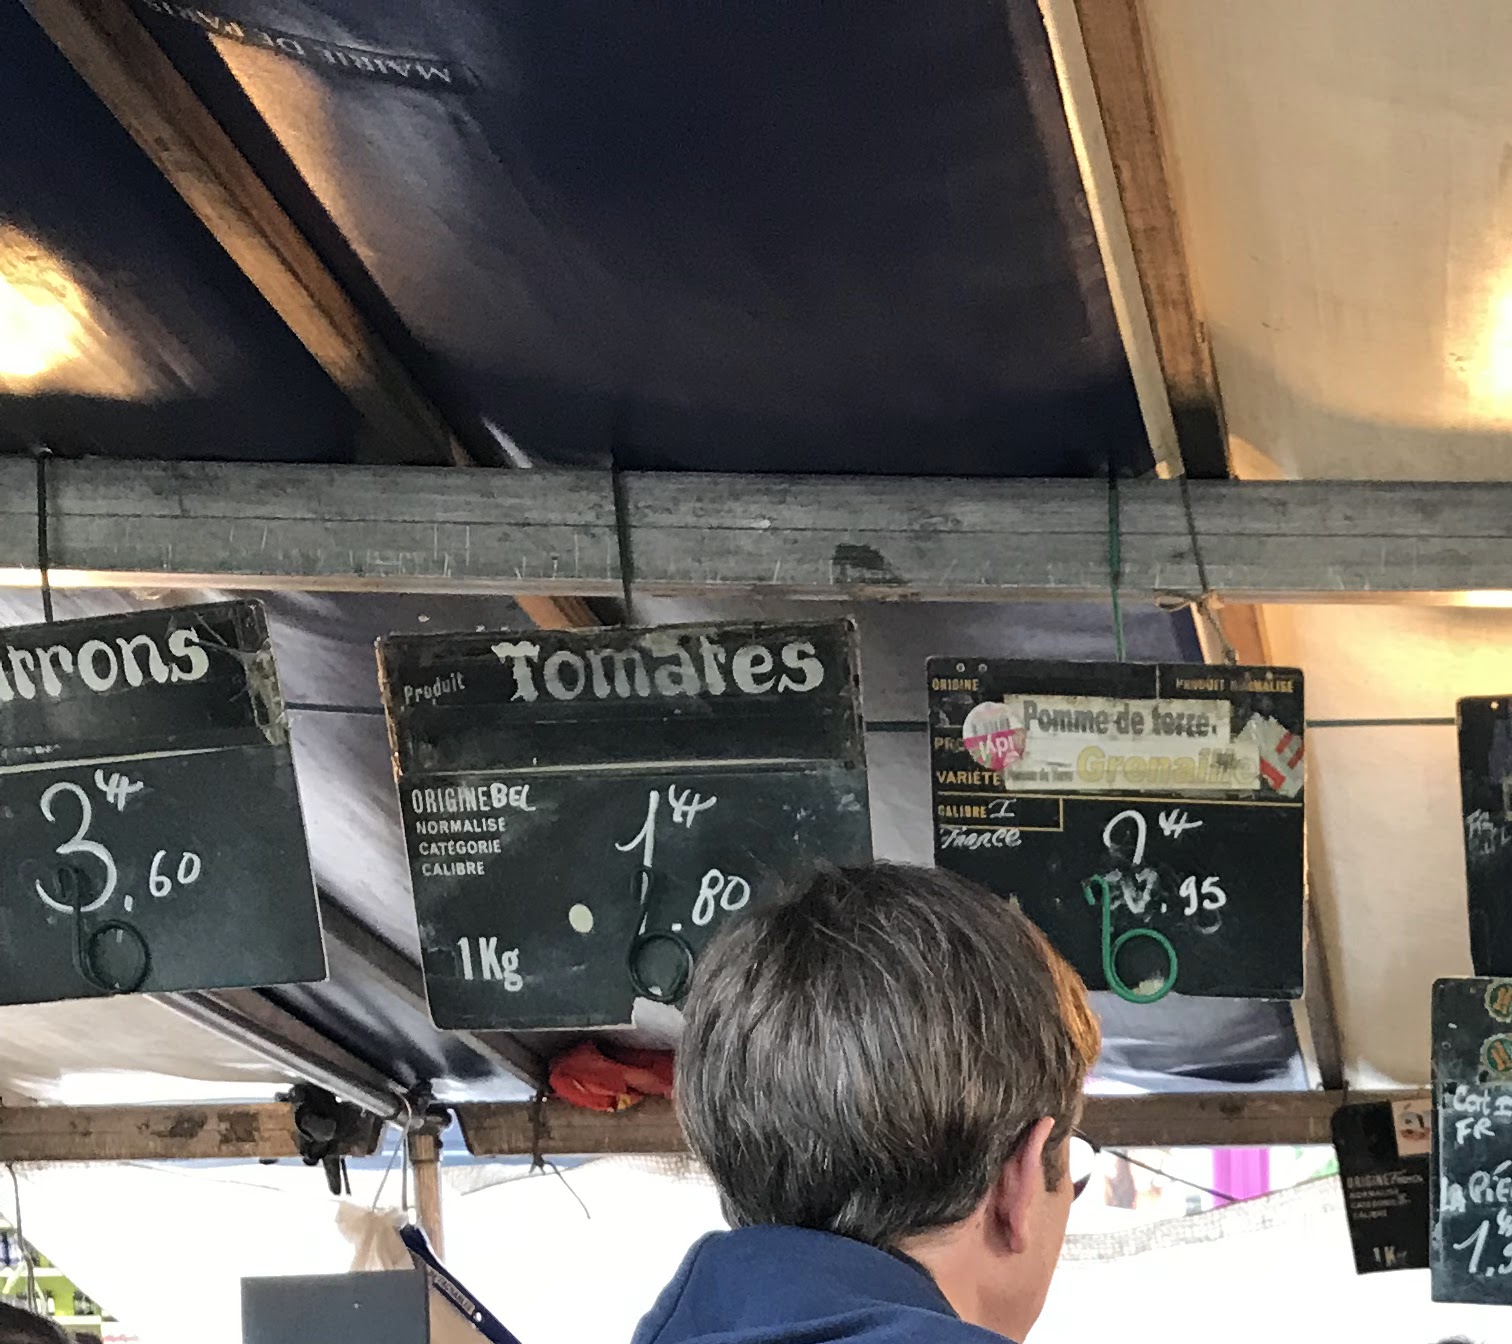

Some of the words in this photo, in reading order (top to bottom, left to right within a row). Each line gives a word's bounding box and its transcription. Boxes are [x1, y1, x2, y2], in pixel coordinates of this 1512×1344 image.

[491, 634, 826, 702] Tomates
[403, 673, 466, 705] Produit
[1023, 698, 1109, 735] Pomme
[1115, 703, 1145, 736] de
[411, 786, 490, 814] ORIGINE
[416, 817, 507, 836] NORMALISE
[421, 861, 486, 878] CALIBRE
